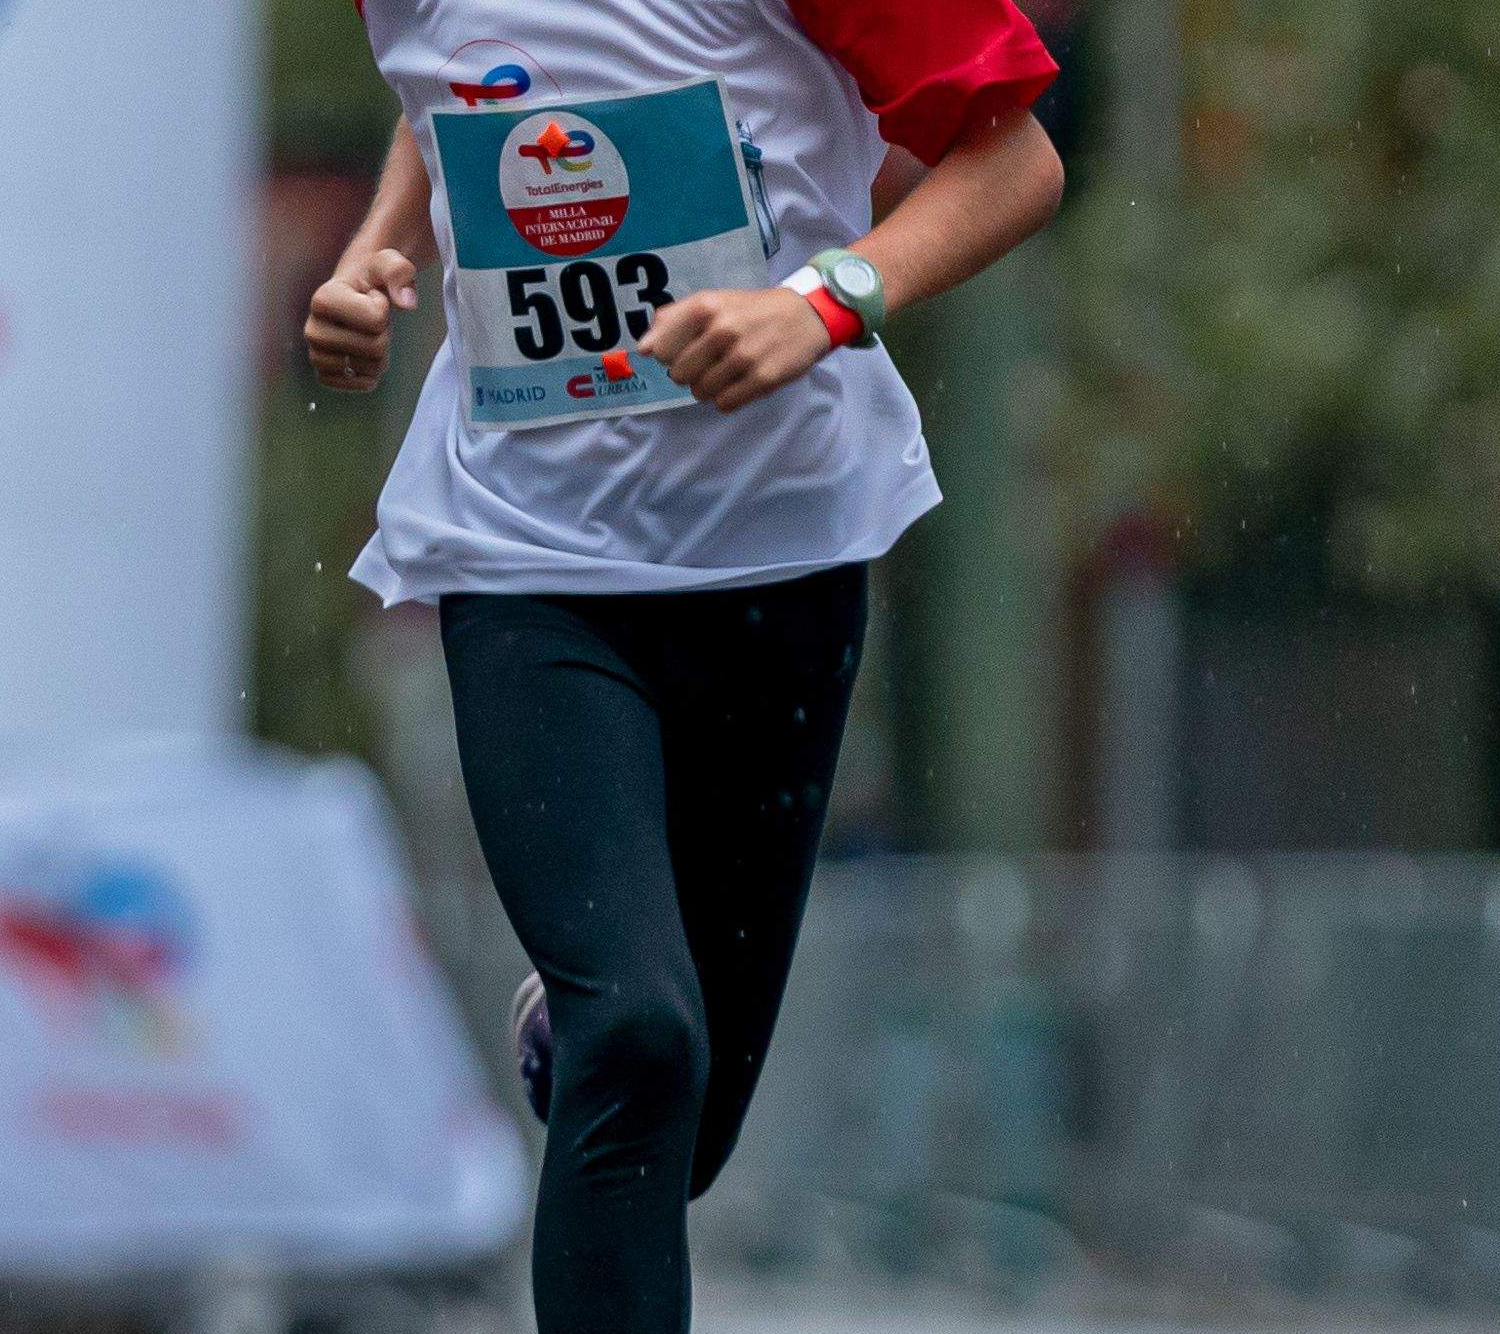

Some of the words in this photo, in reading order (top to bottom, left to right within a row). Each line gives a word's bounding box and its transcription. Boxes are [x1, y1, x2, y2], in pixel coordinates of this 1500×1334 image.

[525, 178, 604, 197] TotalEnergies
[548, 205, 587, 219] MILLA
[525, 215, 617, 236] INTERNACIONAL
[540, 234, 558, 247] DE
[558, 228, 605, 245] MADRID
[506, 253, 674, 361] 593
[486, 386, 546, 405] MADRID
